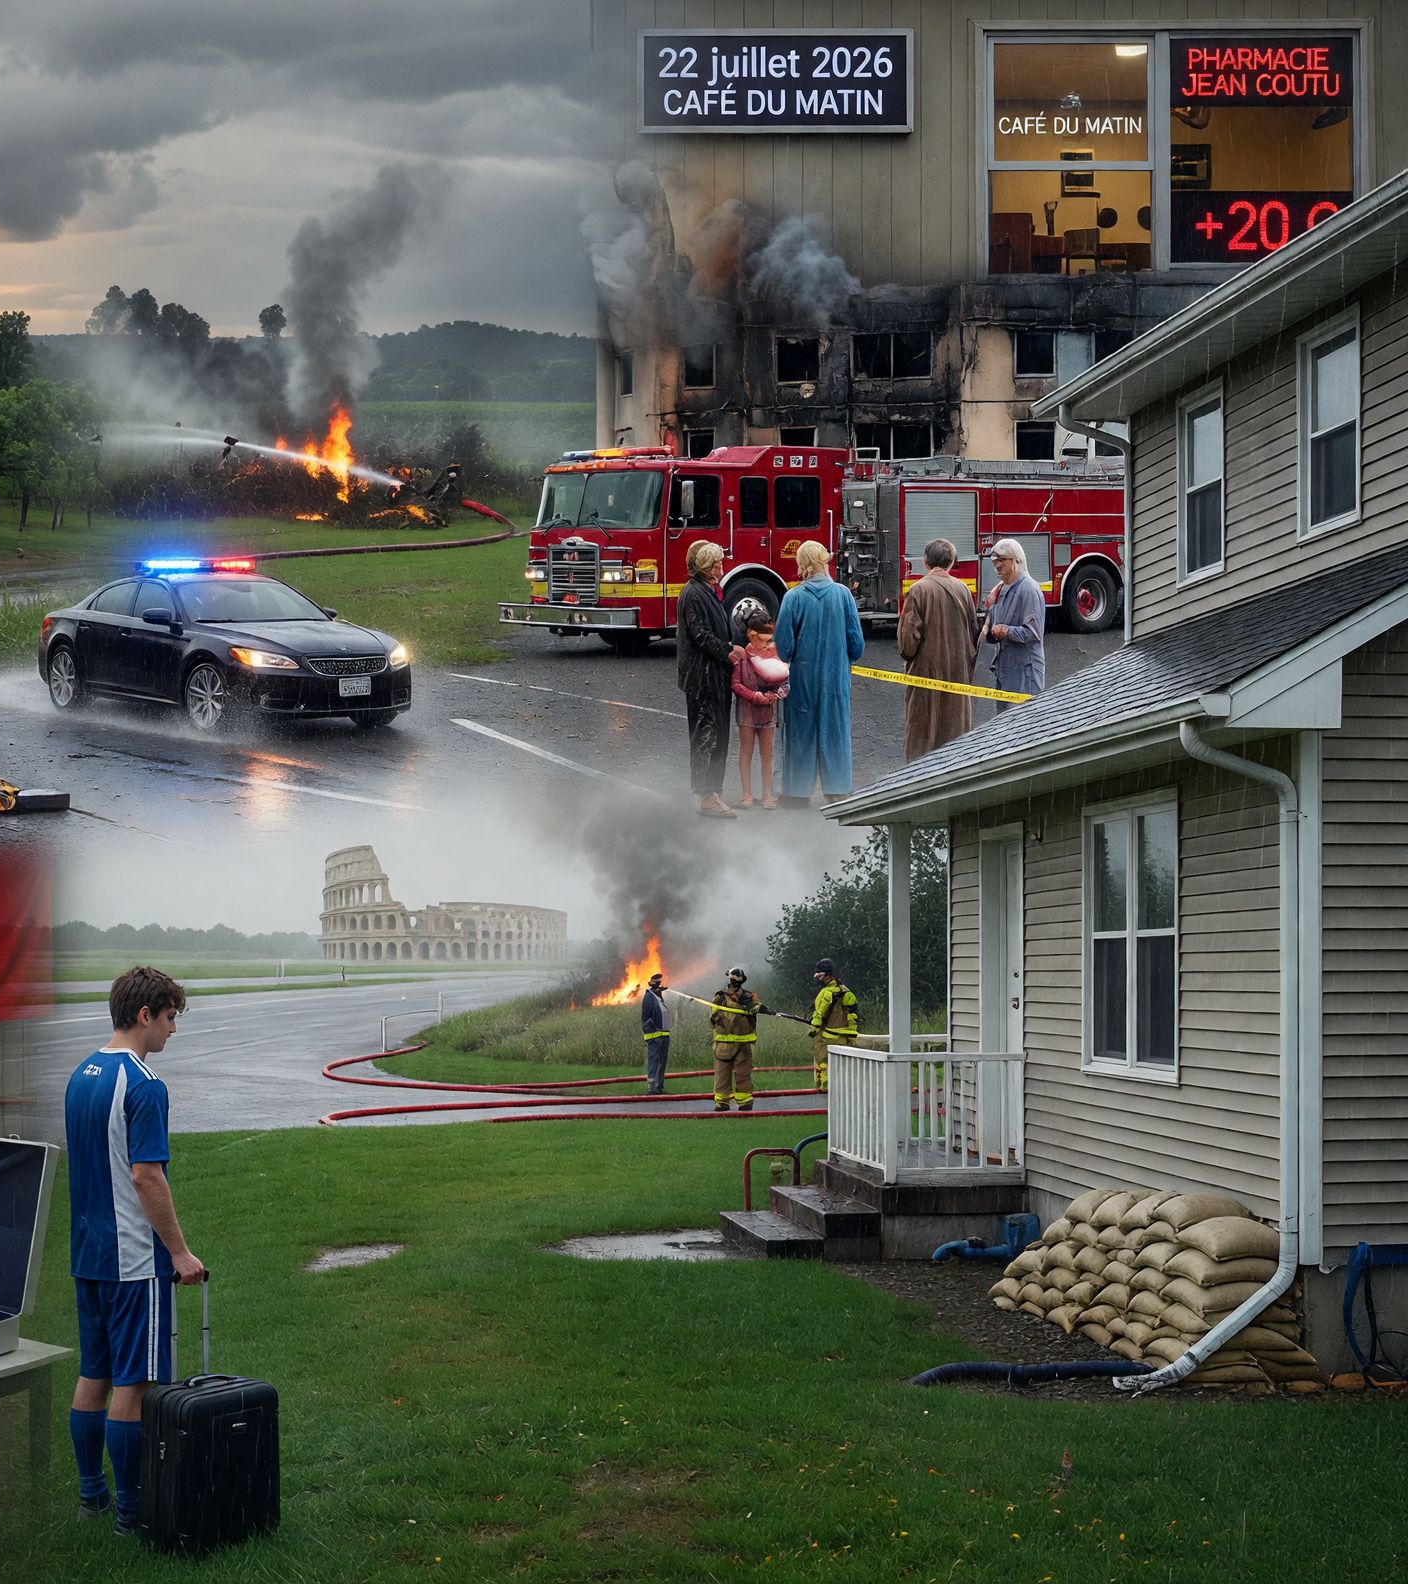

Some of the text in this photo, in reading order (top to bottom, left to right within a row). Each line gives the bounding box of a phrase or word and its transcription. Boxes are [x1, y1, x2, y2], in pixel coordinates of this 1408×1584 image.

[658, 46, 893, 86] 22 juillet 2026
[1188, 47, 1329, 71] PHARMACIE
[663, 83, 883, 116] CAFÉ DU MATIN
[1181, 73, 1340, 97] JEAN COUTU
[998, 110, 1142, 135] CAFÉ DU MATIN
[1195, 200, 1290, 250] +20
